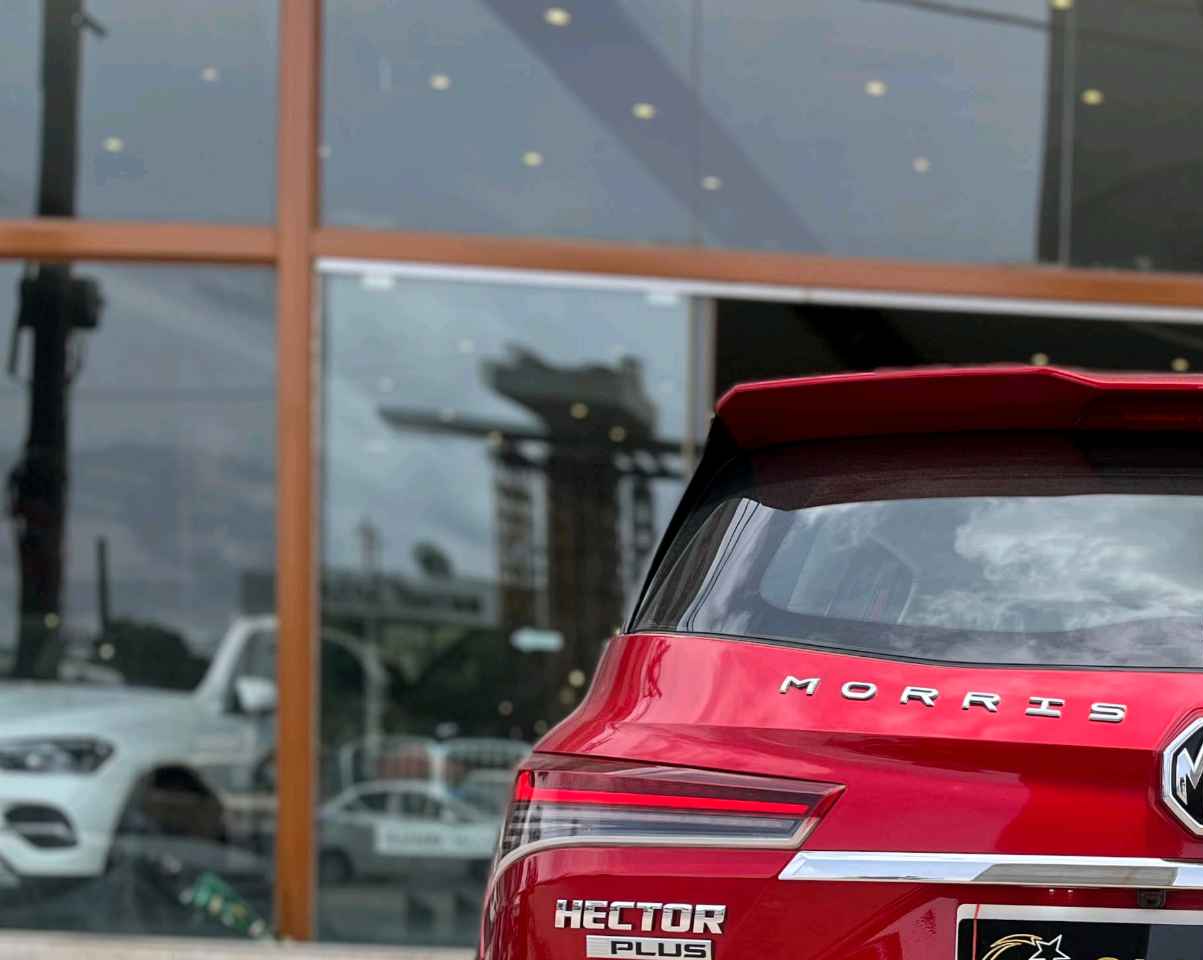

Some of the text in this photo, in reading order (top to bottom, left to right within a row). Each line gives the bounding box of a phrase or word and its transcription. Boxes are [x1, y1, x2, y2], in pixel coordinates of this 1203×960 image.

[779, 675, 1127, 723] MORRIS
[554, 899, 727, 935] HECTOR
[610, 940, 707, 959] PLUS
